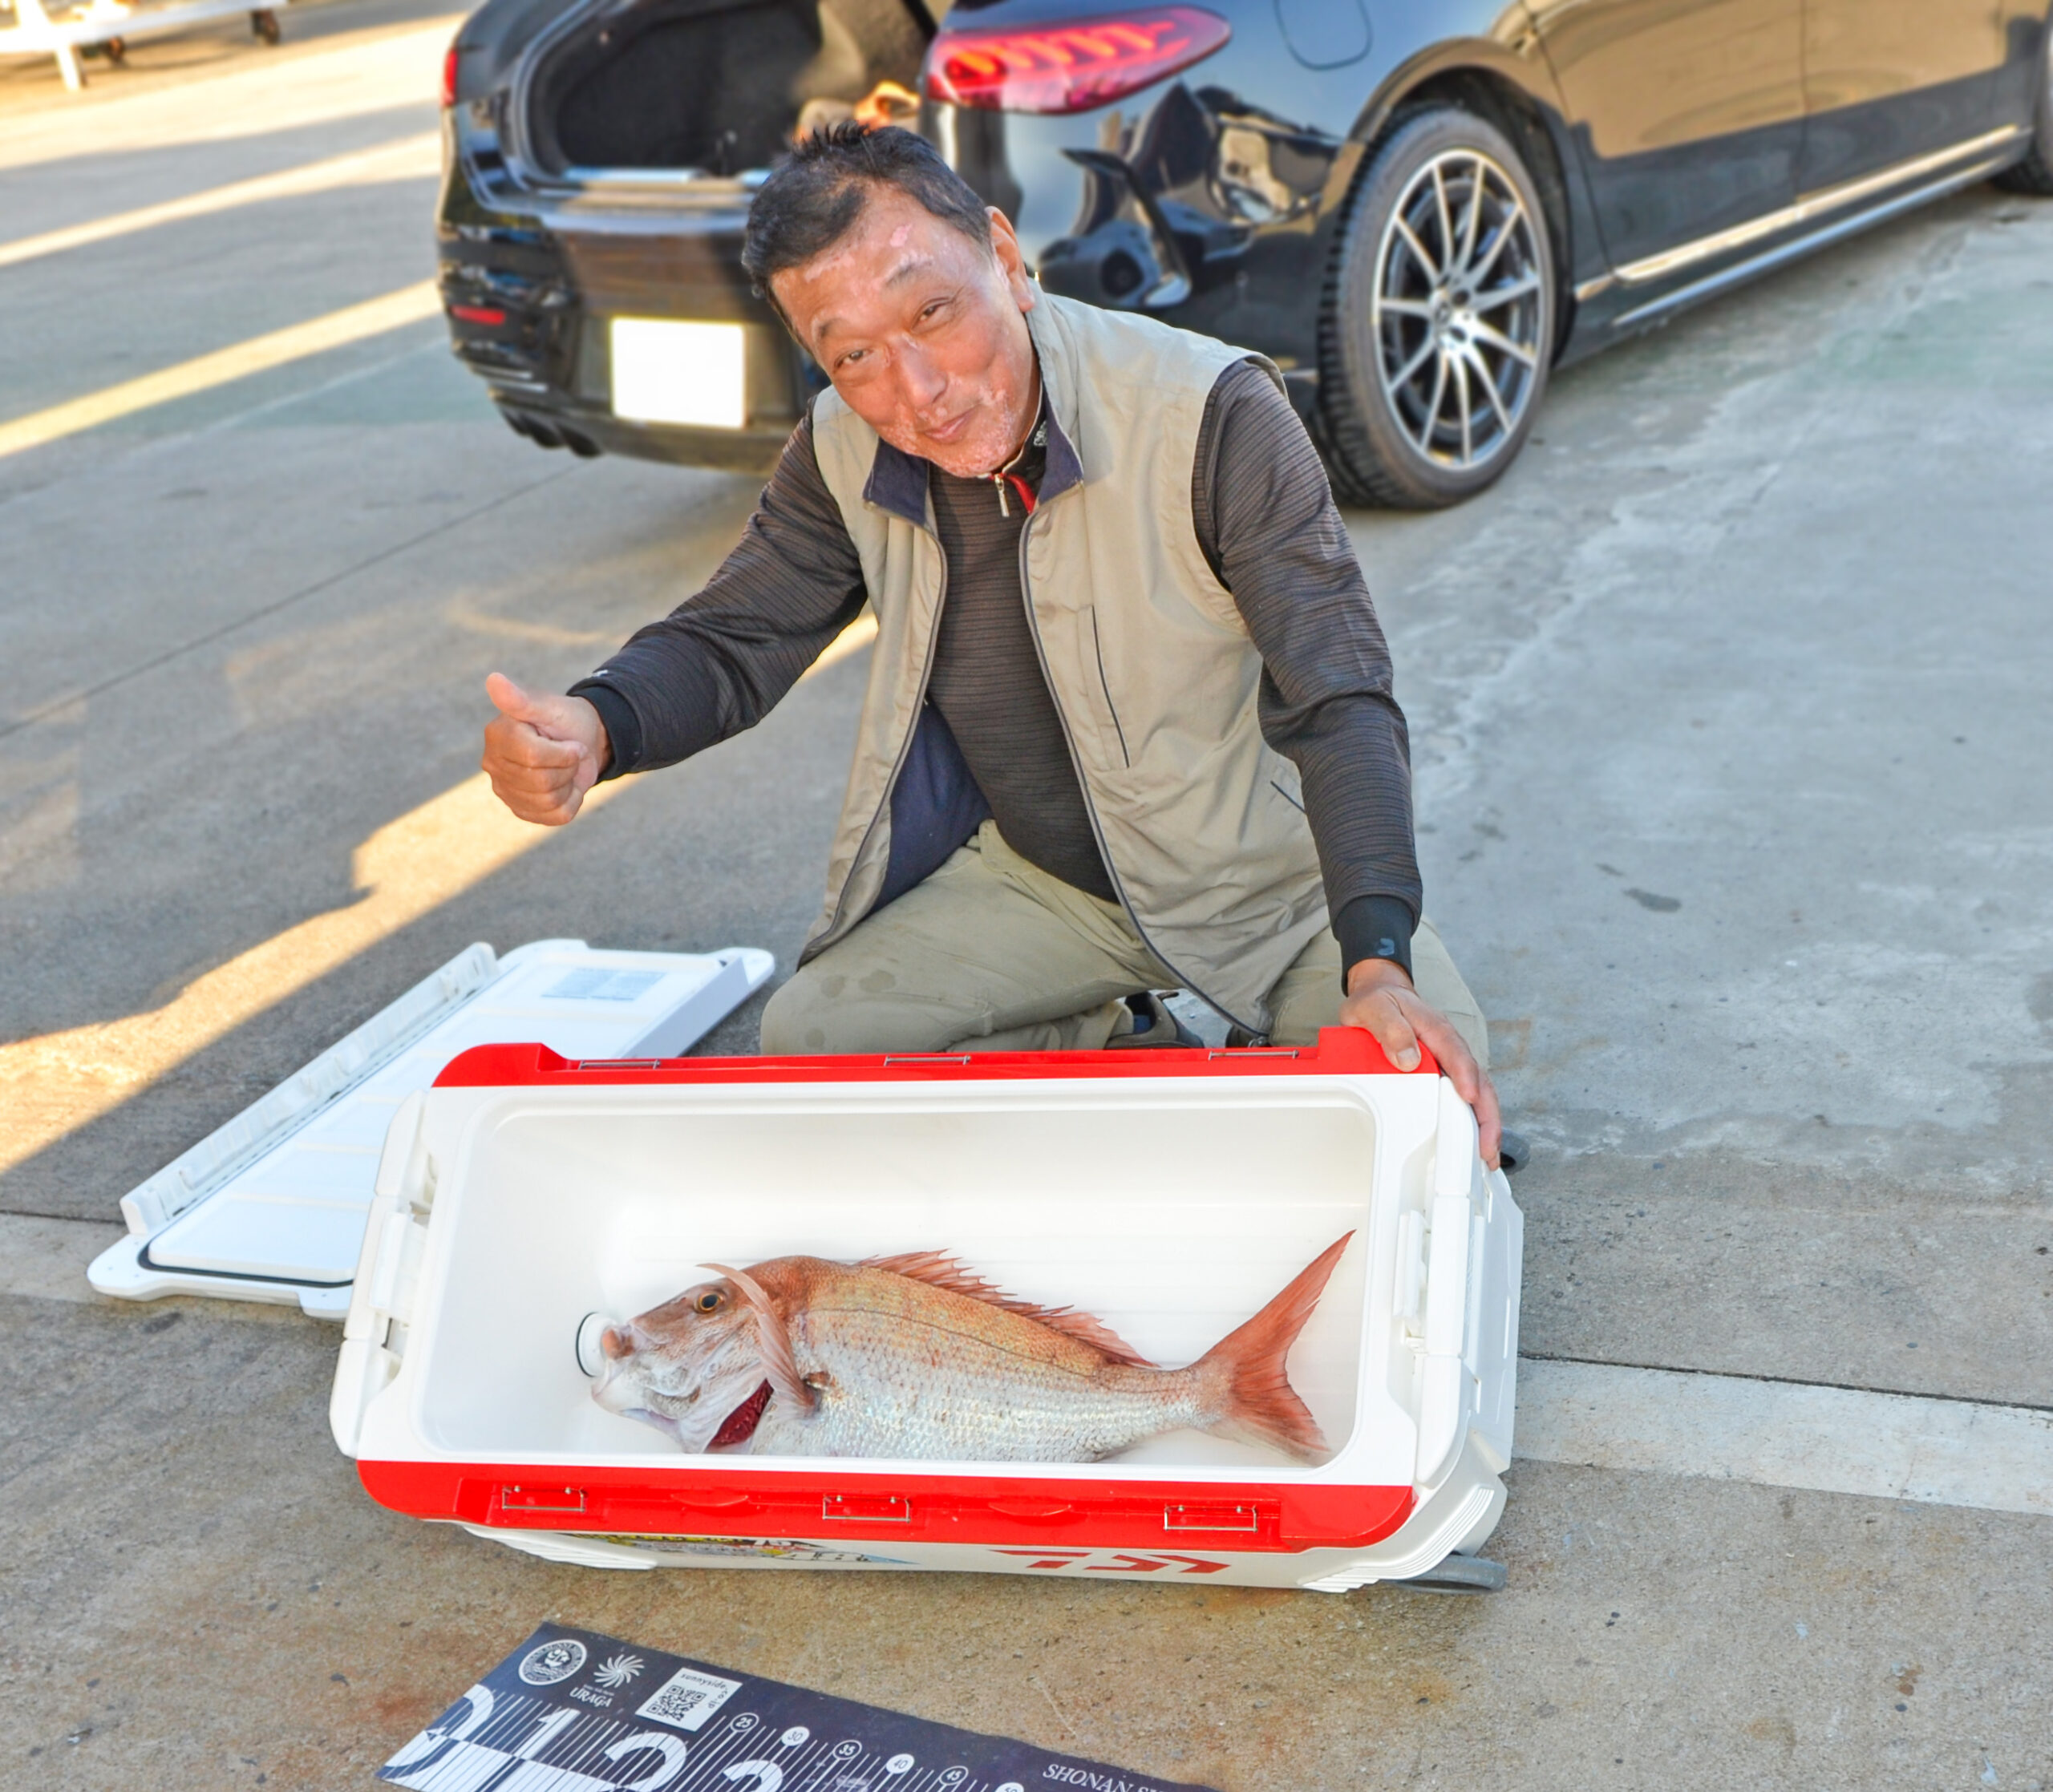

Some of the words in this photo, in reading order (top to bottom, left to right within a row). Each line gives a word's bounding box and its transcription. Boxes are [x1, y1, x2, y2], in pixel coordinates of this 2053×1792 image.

[569, 1687, 613, 1707] URAGA
[735, 1717, 753, 1729] 25
[787, 1730, 804, 1742] 30
[838, 1744, 856, 1756] 35
[893, 1758, 909, 1770] 40
[946, 1770, 963, 1782] 45
[1043, 1763, 1134, 1792] SHONAN
